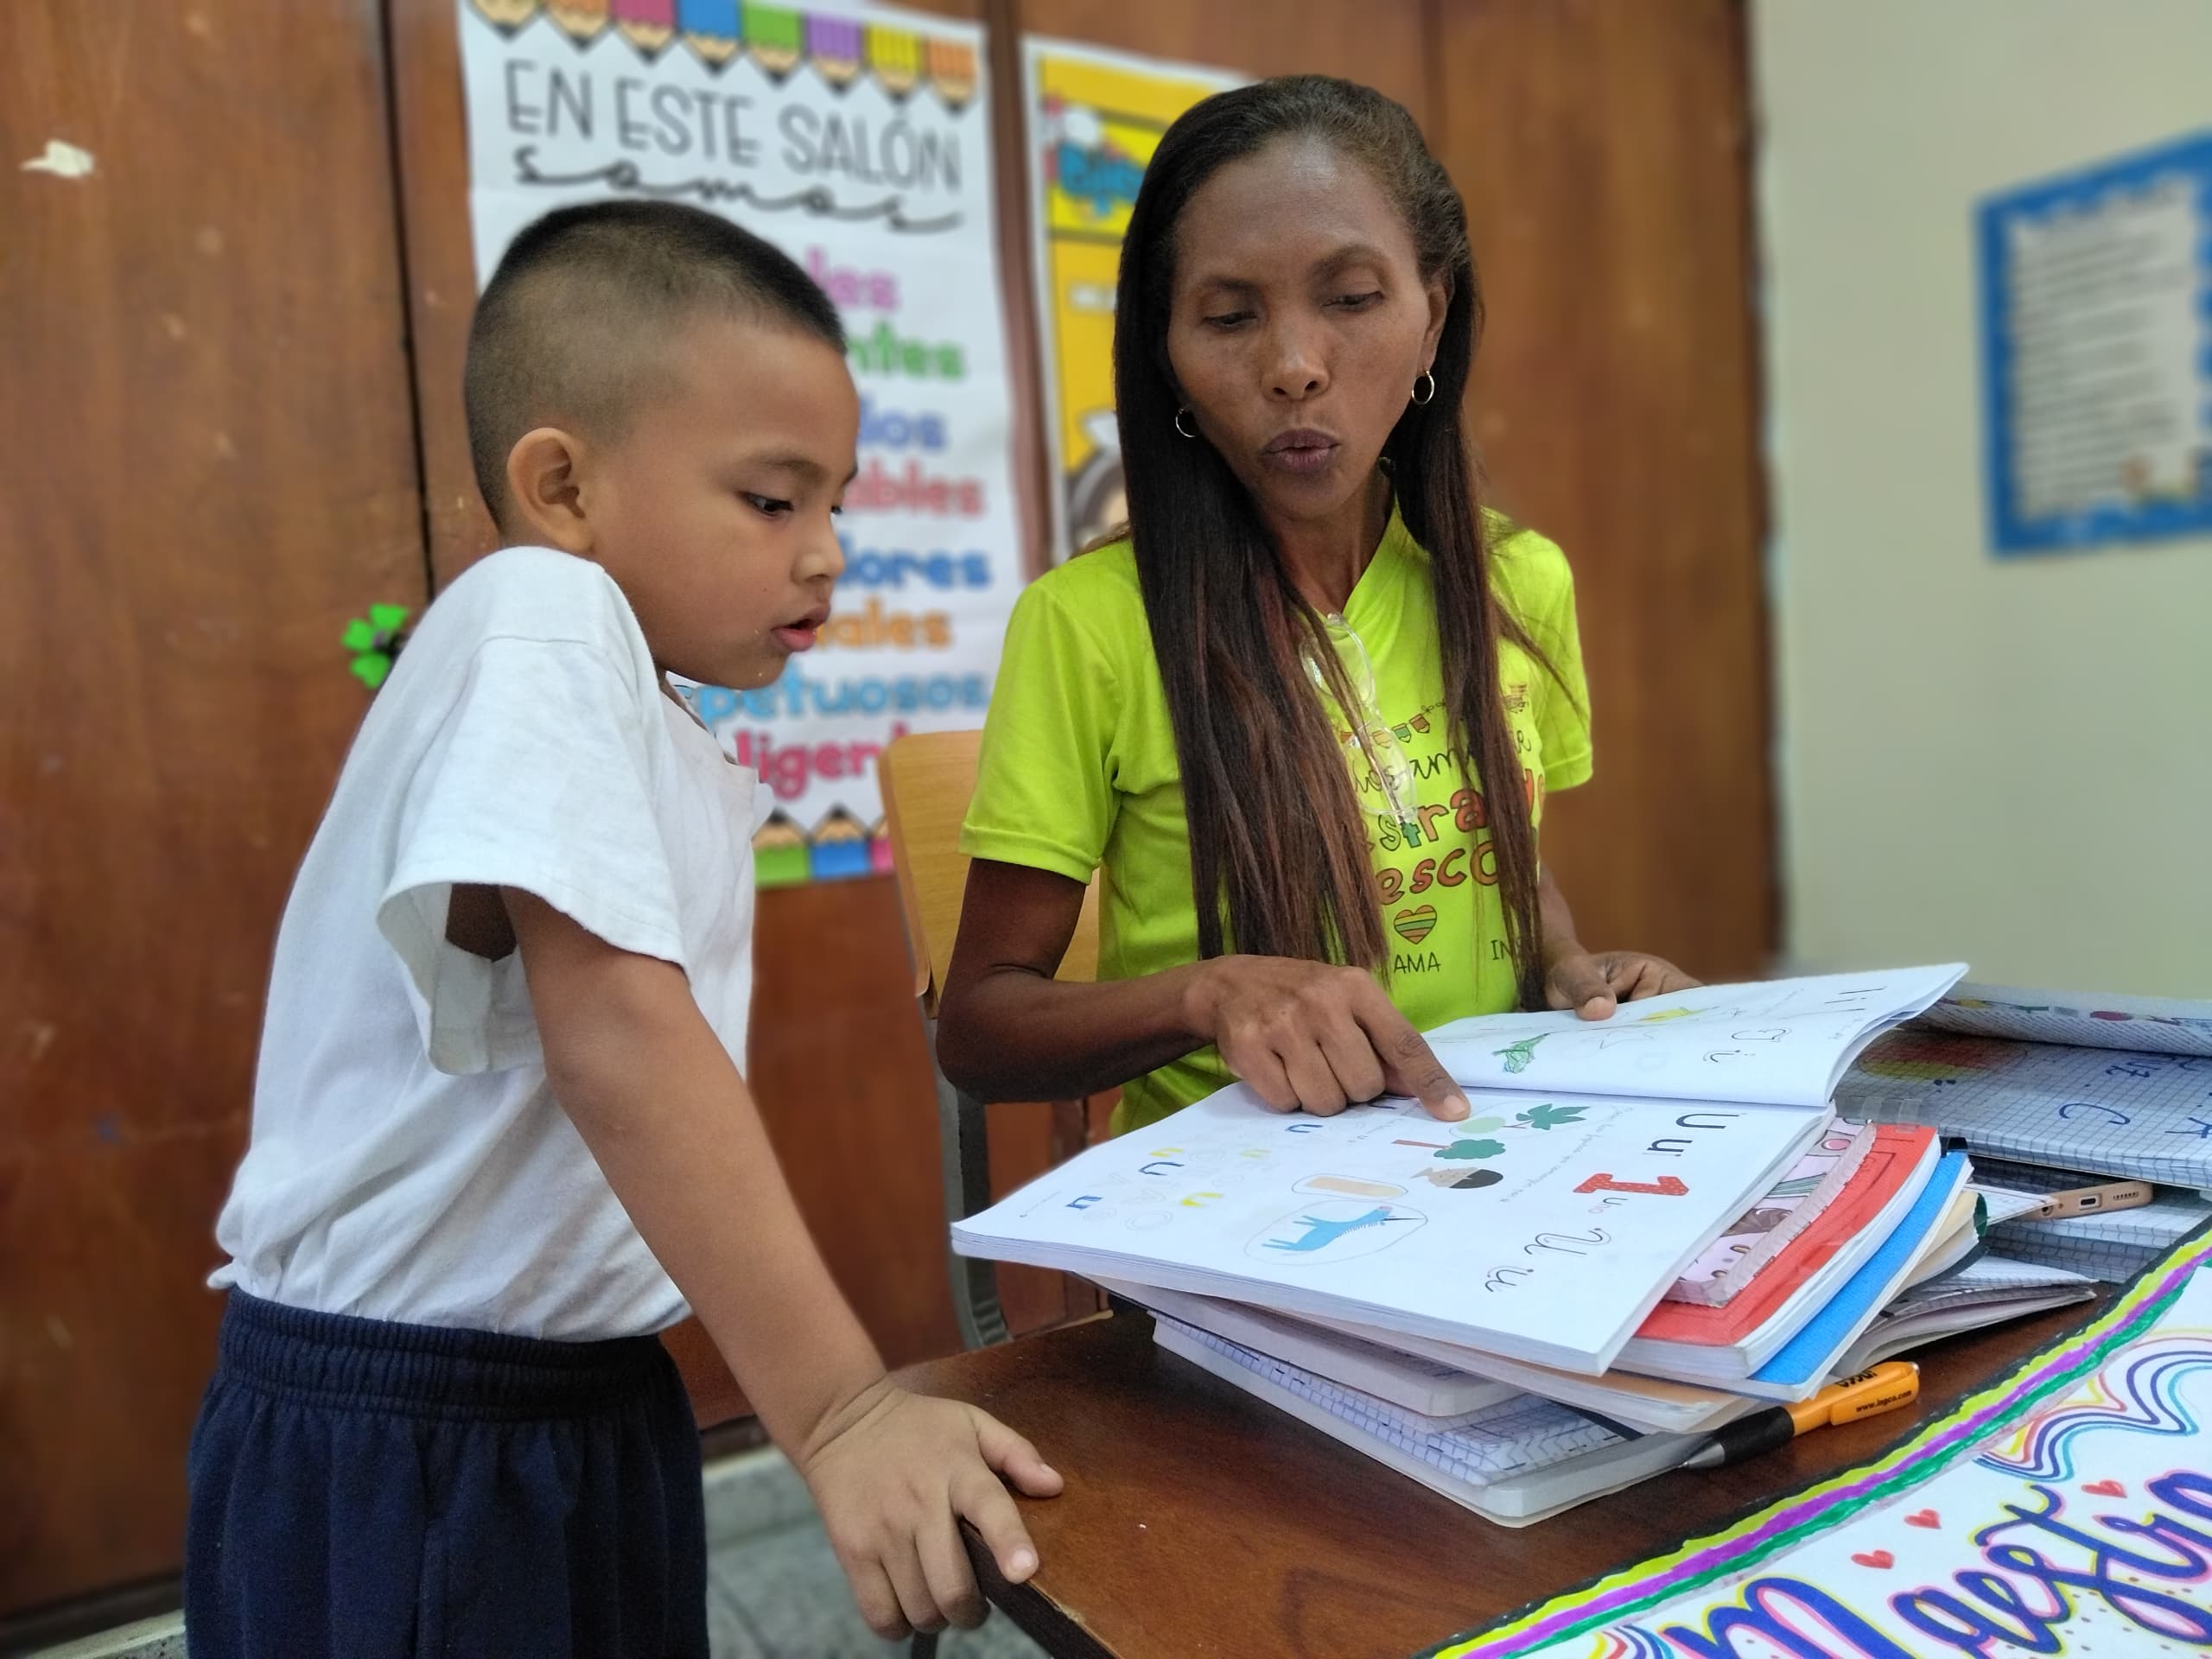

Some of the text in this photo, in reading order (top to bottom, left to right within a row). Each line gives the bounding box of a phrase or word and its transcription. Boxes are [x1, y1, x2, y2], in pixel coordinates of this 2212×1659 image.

[505, 59, 594, 142] EN
[615, 76, 762, 168] ESTE
[778, 102, 963, 196] SALÓN
[513, 143, 967, 236] somos
[805, 247, 900, 312] les
[847, 318, 967, 382] ntes
[842, 458, 984, 518] ables
[683, 661, 989, 731] petuosos
